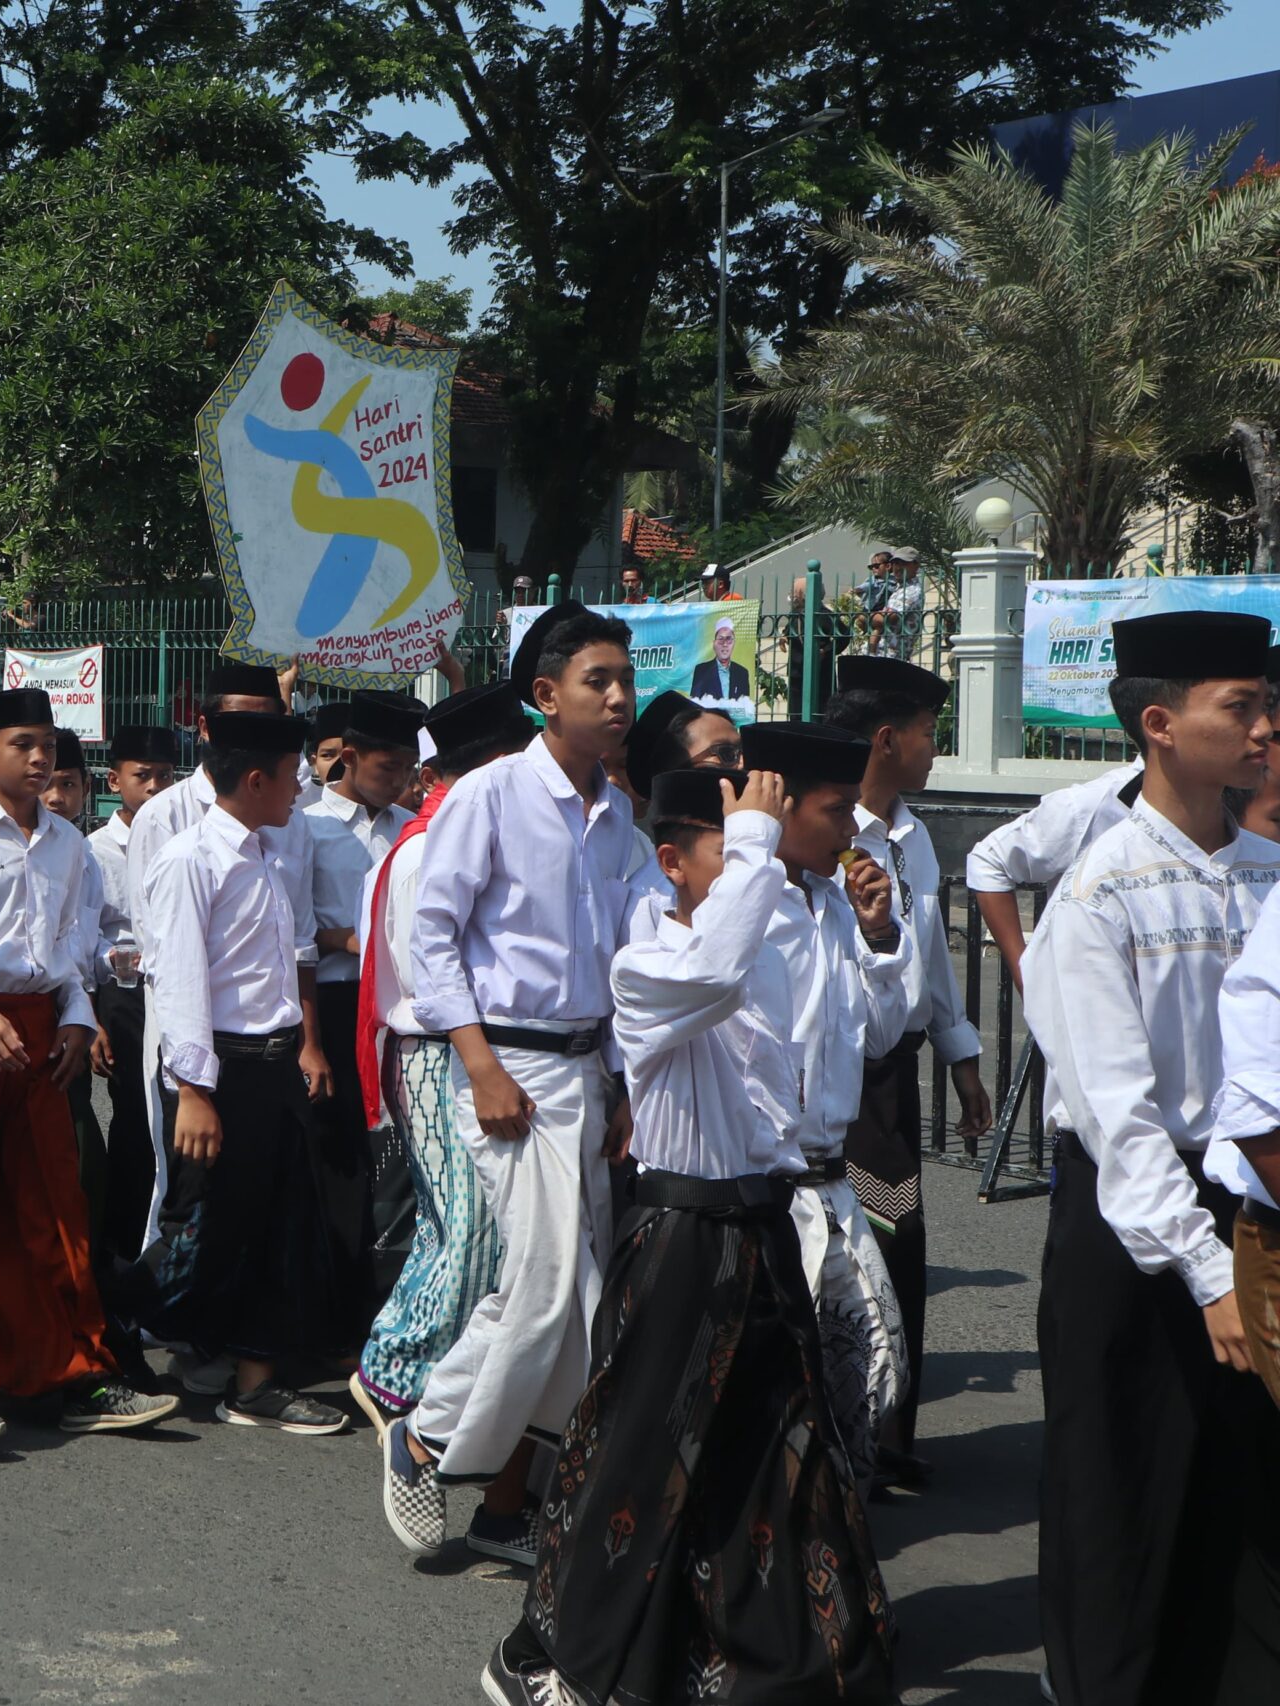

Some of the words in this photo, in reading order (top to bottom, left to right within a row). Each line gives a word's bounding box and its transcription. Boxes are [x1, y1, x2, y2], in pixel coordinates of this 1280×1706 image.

[355, 394, 400, 432] Hari
[378, 452, 428, 488] 2024
[423, 597, 464, 629] juang
[1048, 617, 1102, 640] Selamat
[399, 629, 447, 654] masa
[1048, 639, 1094, 665] HARI
[629, 646, 673, 669] SIONAL
[24, 680, 42, 689] ANDA
[1048, 671, 1059, 680] 22
[1060, 670, 1100, 680] Oktober
[1101, 669, 1120, 678] 202
[50, 694, 63, 704] NPA
[66, 692, 95, 705] ROKOK
